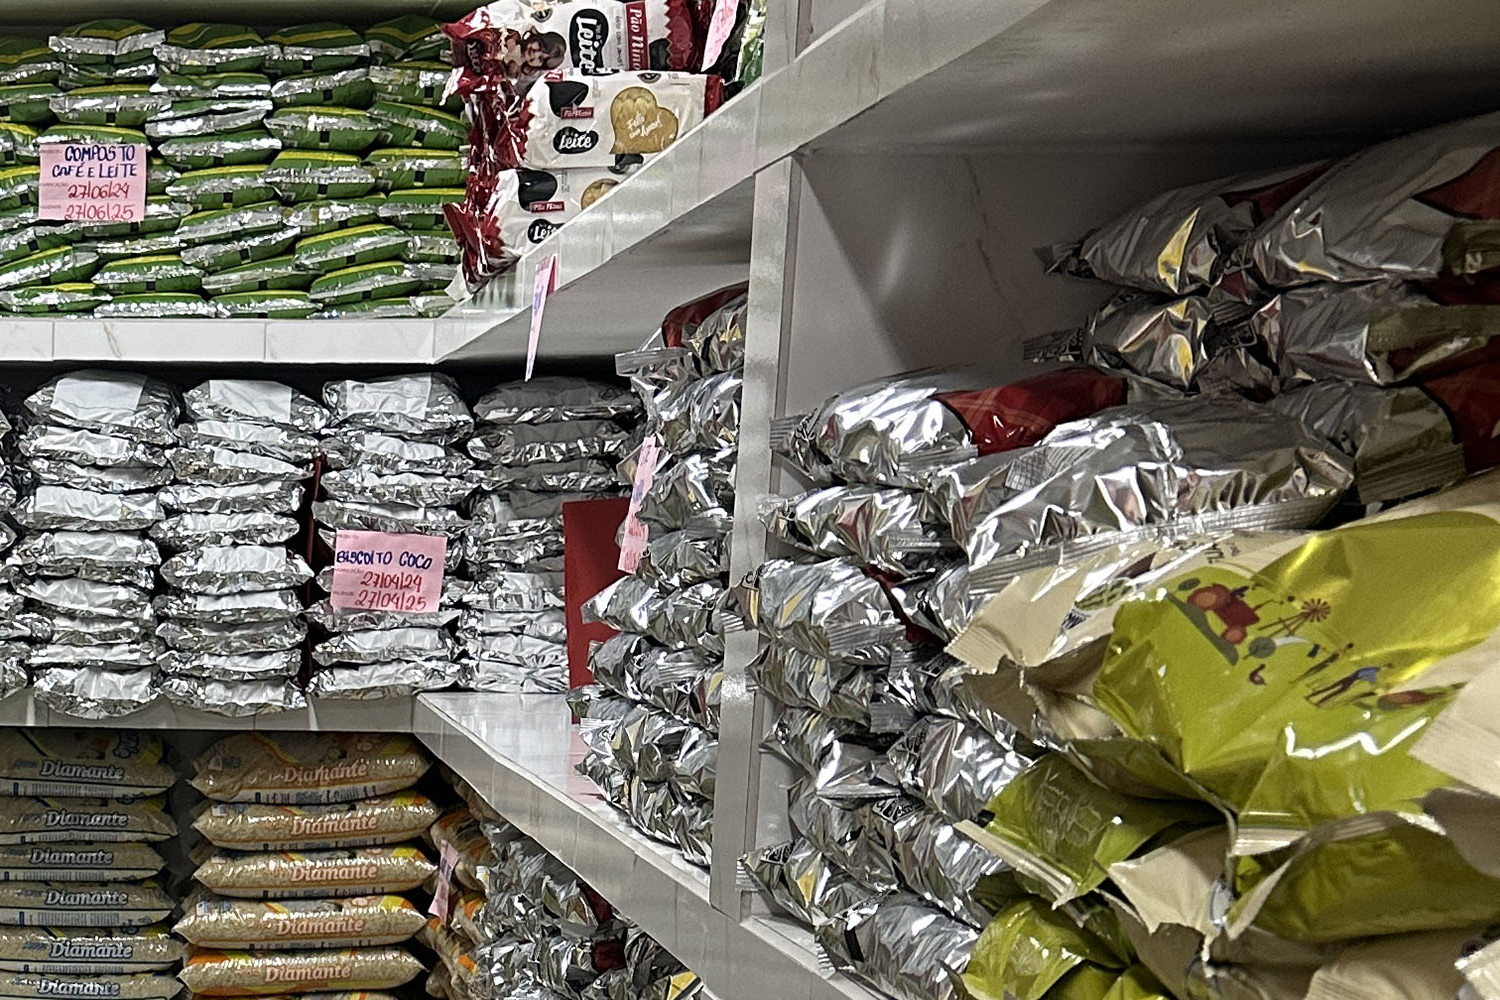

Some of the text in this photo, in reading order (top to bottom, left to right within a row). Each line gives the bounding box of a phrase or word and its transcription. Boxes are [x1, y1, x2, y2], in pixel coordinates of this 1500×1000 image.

[630, 8, 645, 35] Pão
[576, 16, 599, 75] Leite
[559, 129, 592, 150] Leite
[52, 162, 138, 178] CAFÉ E LEITE
[399, 551, 433, 570] COCO
[40, 759, 124, 781] Diamante
[282, 763, 368, 786] Diamante
[45, 808, 129, 827] Diamante
[290, 815, 378, 837] Diamante
[29, 848, 114, 866] Diamante
[290, 864, 379, 883] Diamante
[45, 889, 129, 906] Diamante
[276, 917, 365, 937] Diamante
[49, 941, 134, 959] Diamante
[265, 964, 353, 984] Diamante
[37, 977, 121, 997] Diamante
